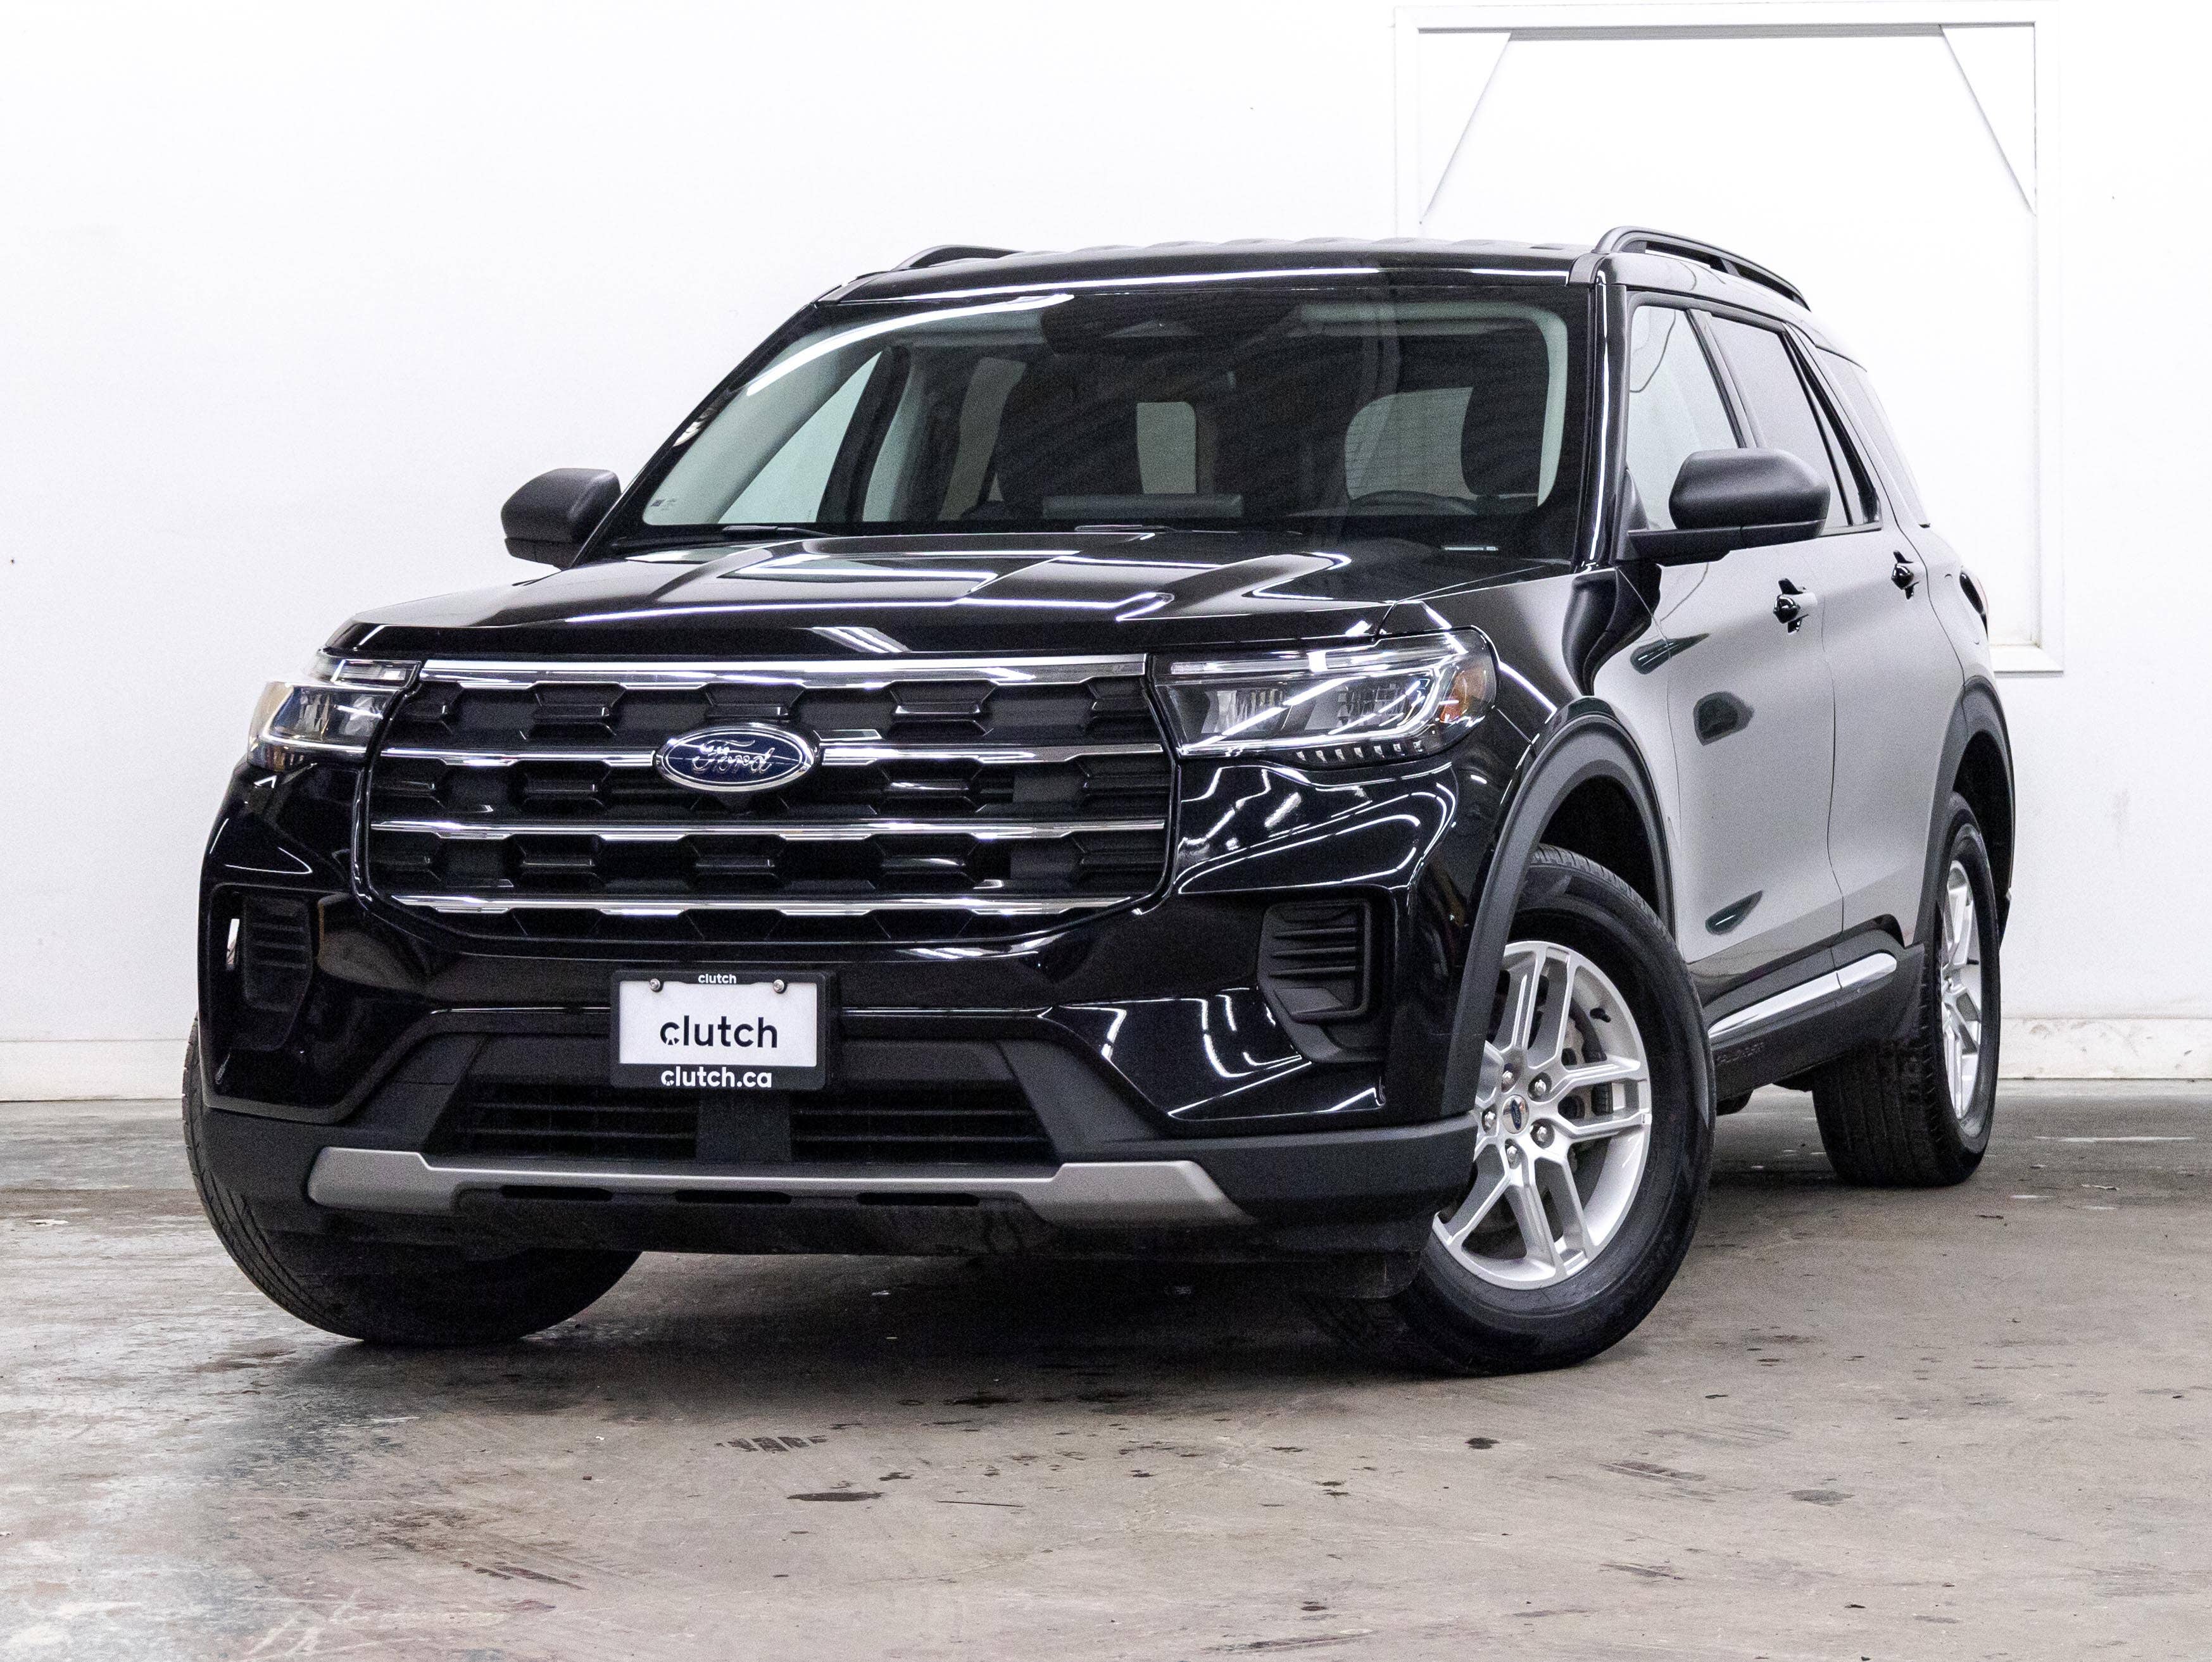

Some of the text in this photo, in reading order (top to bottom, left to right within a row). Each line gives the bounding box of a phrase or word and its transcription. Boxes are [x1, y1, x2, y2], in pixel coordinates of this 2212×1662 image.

[692, 739, 776, 773] Ford
[698, 973, 737, 984] clutch
[660, 1015, 778, 1048] clutch
[660, 1066, 772, 1088] clutch.ca
